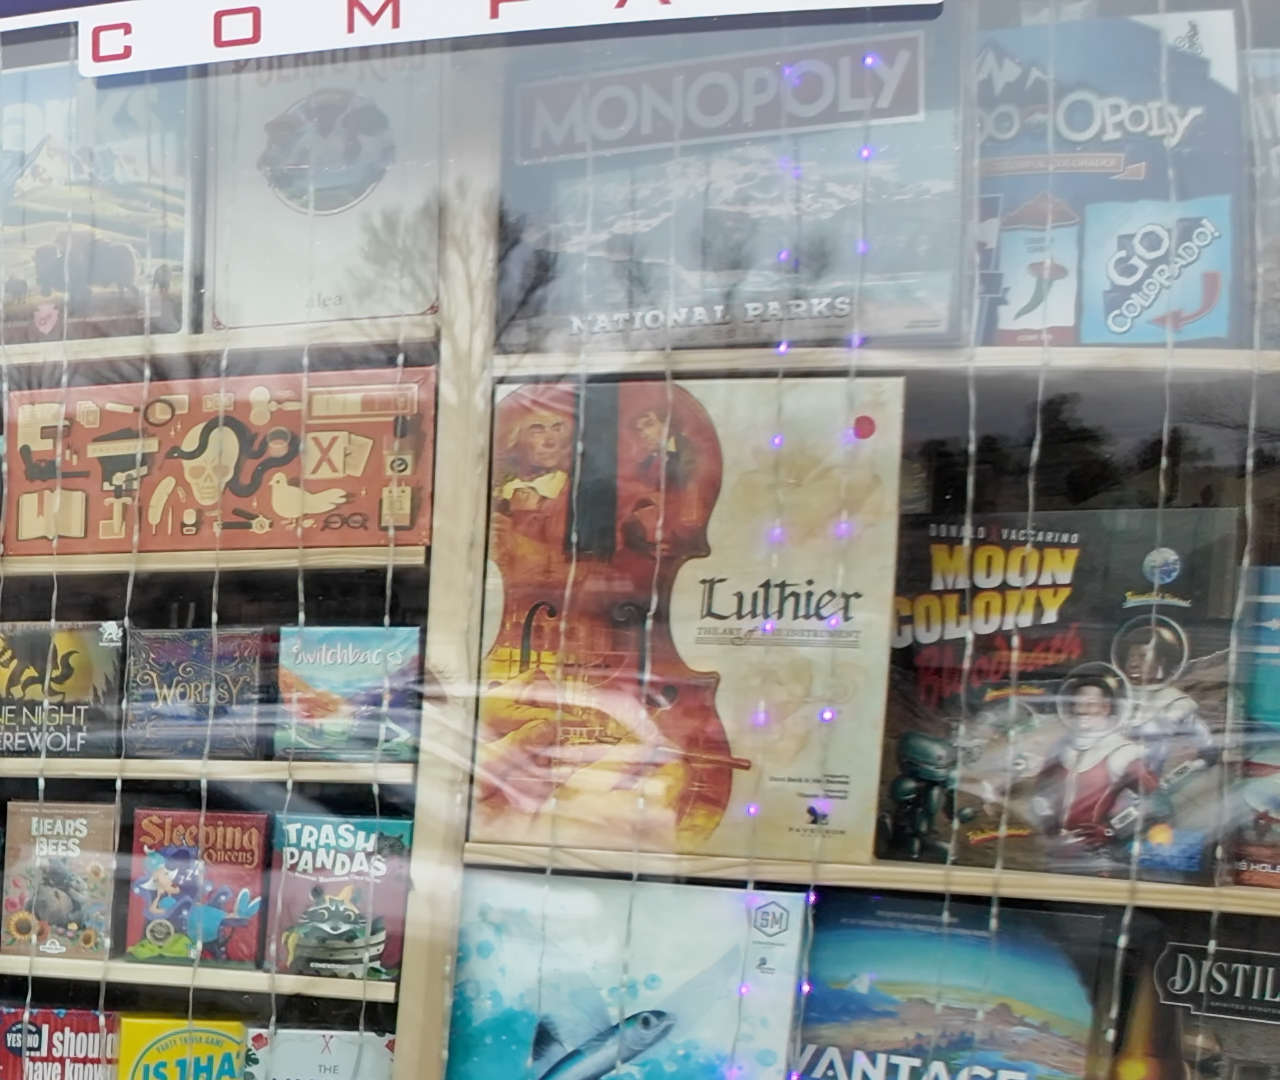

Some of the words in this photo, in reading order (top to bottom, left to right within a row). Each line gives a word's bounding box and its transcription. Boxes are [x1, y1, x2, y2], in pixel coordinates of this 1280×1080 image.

[531, 49, 912, 149] MONOPOLY
[1107, 224, 1170, 286] GO
[1107, 218, 1221, 334] COLORADO!
[570, 304, 731, 337] NATIONAL
[743, 296, 852, 324] PARKS
[1001, 527, 1080, 544] VACCARINO
[929, 543, 1080, 591] MOON
[699, 576, 863, 623] Luthier
[891, 586, 1073, 649] COLONY
[292, 642, 404, 667] Switchbacs
[22, 706, 89, 726] NIGHT
[31, 815, 89, 838] BEARS
[284, 824, 377, 852] TRASH
[36, 837, 81, 858] BEES
[139, 814, 262, 868] Sleeping
[203, 849, 254, 867] Queens
[284, 846, 388, 877] PANDAS
[6, 1031, 22, 1048] YES
[155, 1039, 178, 1054] PARTY
[318, 1064, 340, 1074] THE
